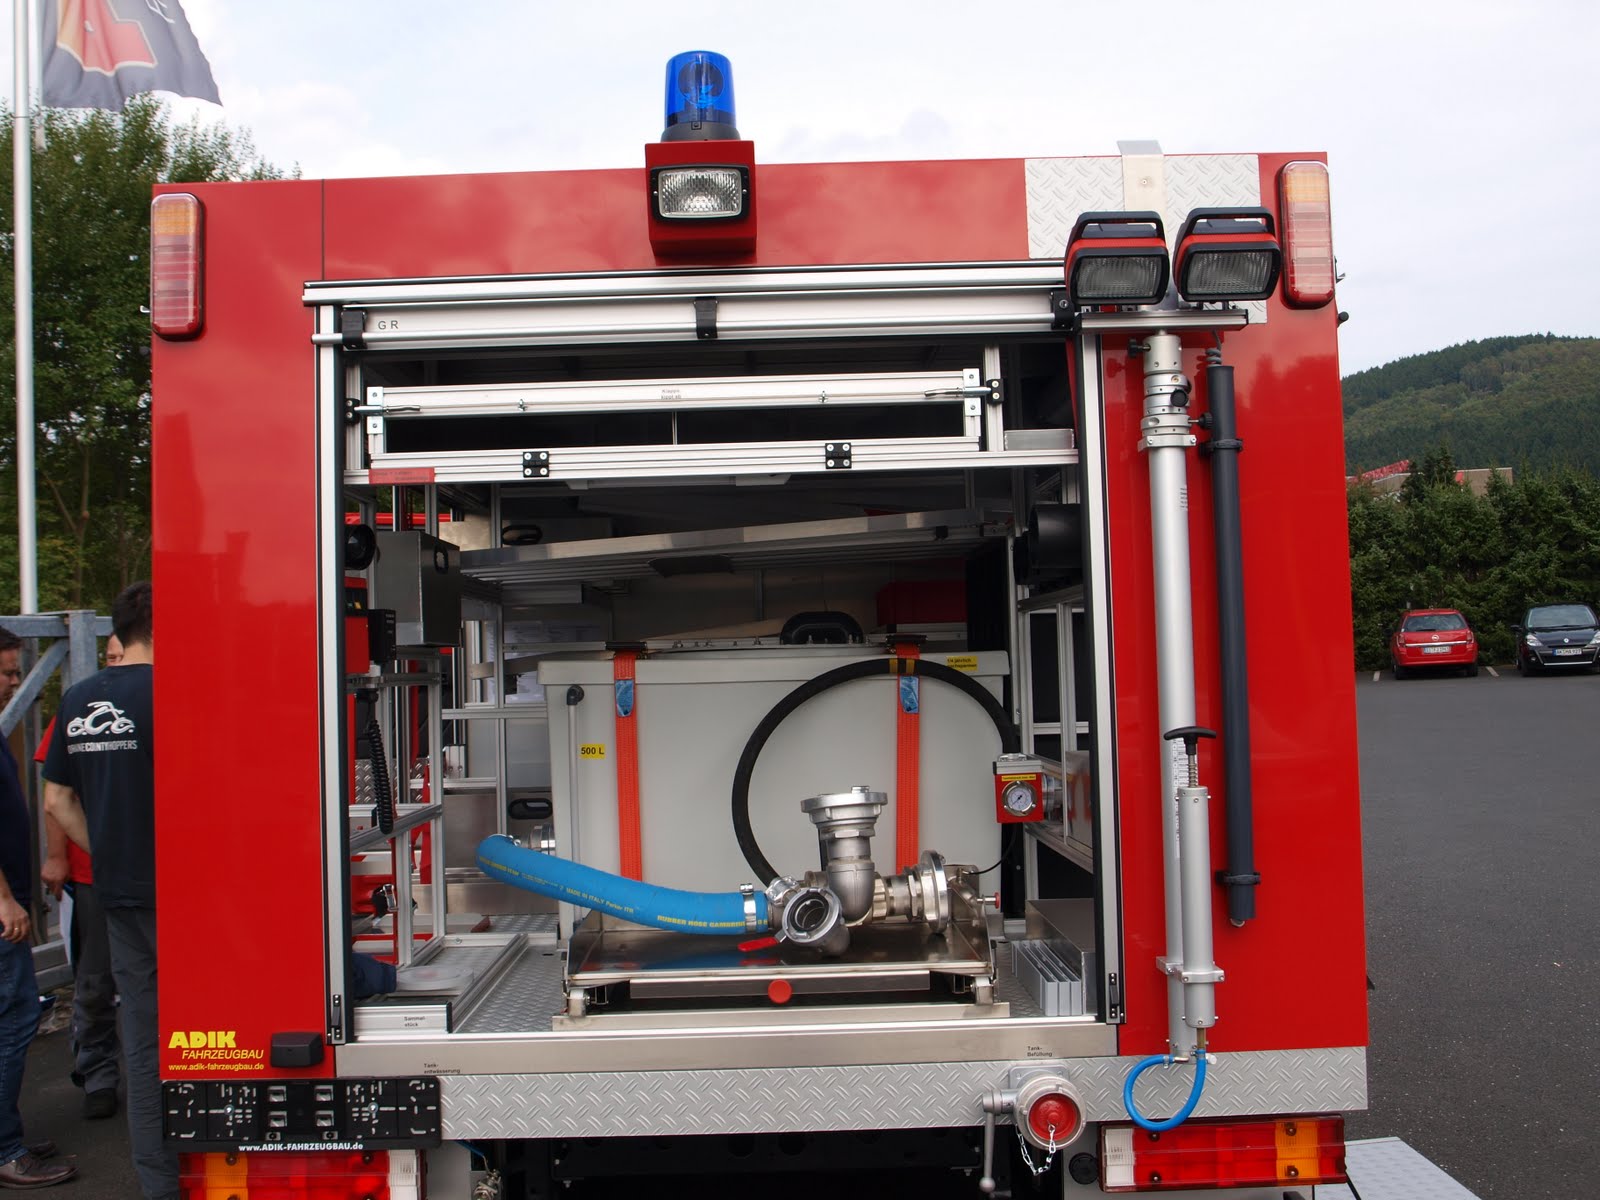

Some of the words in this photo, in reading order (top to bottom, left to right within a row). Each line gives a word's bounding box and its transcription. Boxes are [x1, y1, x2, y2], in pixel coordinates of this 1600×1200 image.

[581, 746, 597, 755] 500
[598, 746, 605, 755] L
[657, 915, 687, 926] RUBBER
[688, 920, 708, 928] HOSE
[168, 1031, 237, 1048] ADIK
[182, 1049, 265, 1060] FAHRZEUGBAU
[168, 1062, 265, 1072] www.adik-fahrzeugbau.de
[238, 1141, 364, 1152] www.ADIK-FAHRZEUGBAU.de
